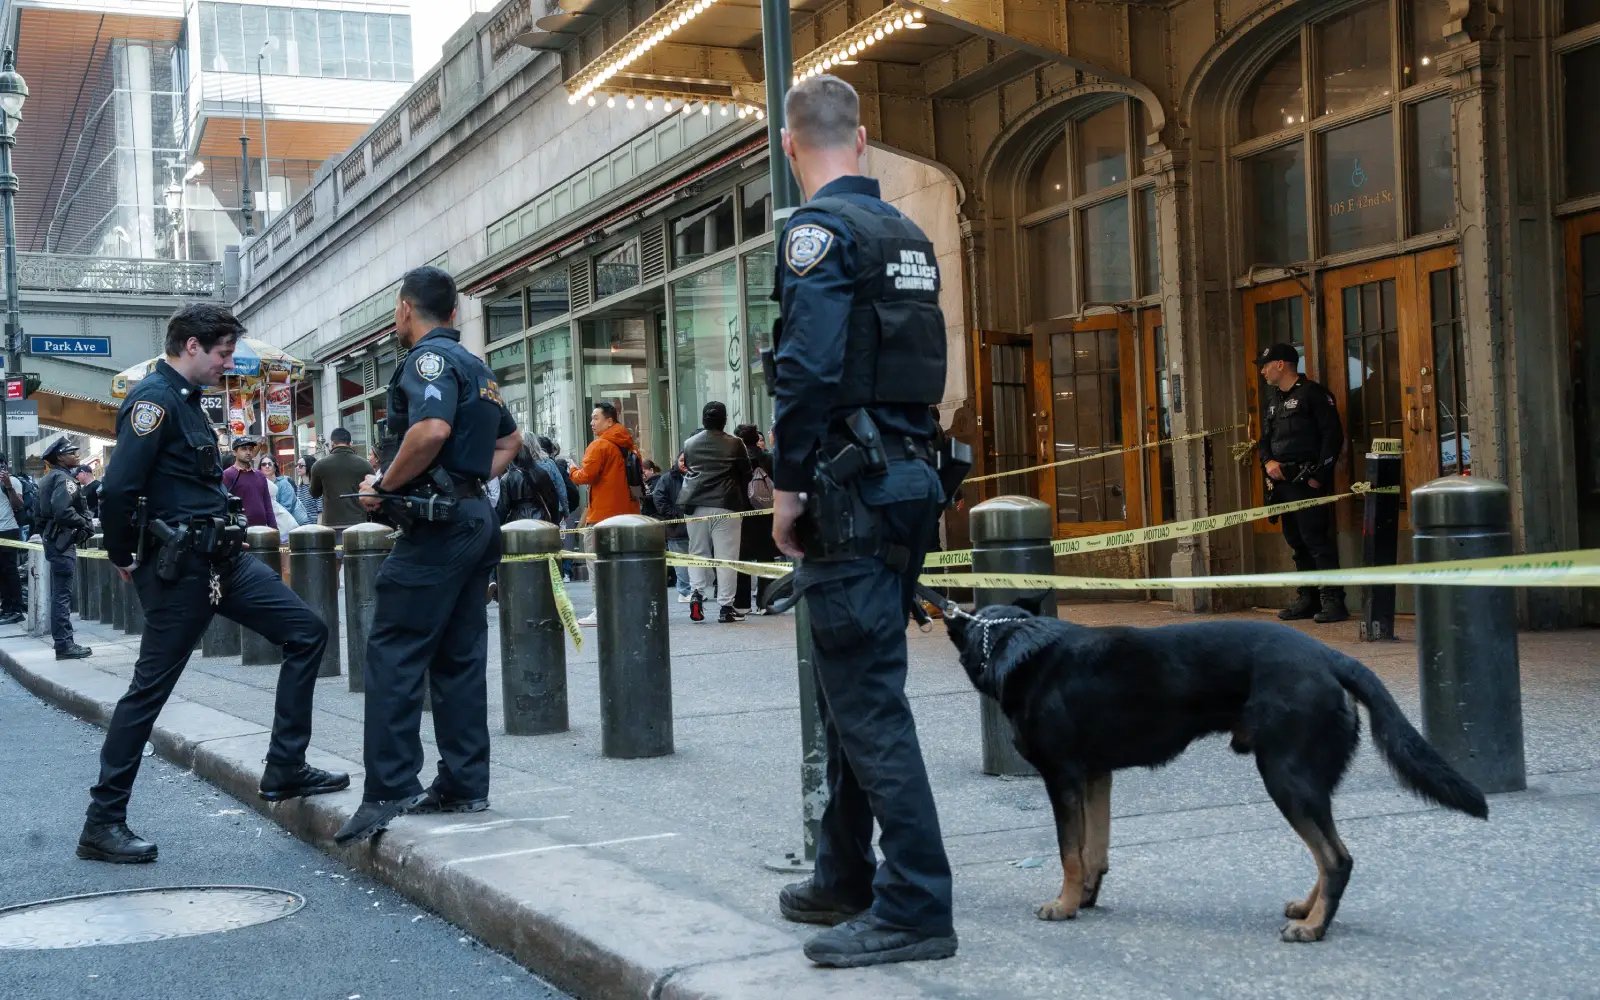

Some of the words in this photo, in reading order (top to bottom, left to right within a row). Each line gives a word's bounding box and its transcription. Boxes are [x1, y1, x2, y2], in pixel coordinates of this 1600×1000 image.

[1329, 201, 1344, 217] 105
[1348, 198, 1355, 212] E
[886, 262, 937, 279] POLICE
[44, 341, 71, 351] Park
[74, 341, 96, 351] Ave
[136, 403, 162, 418] POLICE
